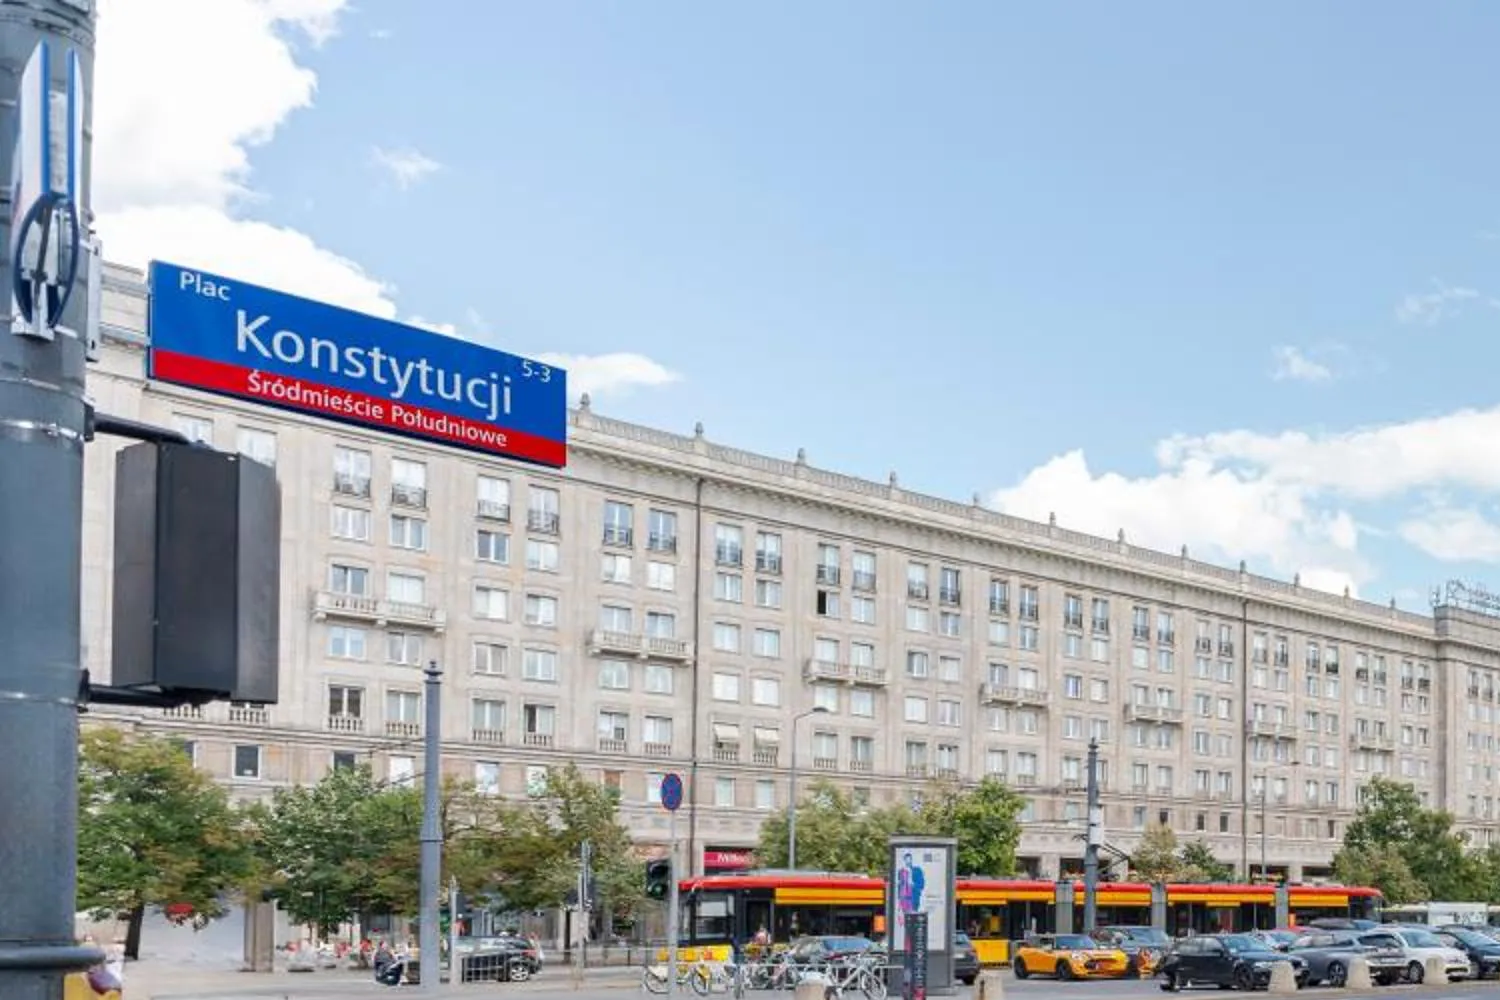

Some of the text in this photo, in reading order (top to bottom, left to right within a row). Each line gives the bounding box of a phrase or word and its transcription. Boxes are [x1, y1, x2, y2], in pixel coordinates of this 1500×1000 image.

[180, 271, 231, 301] Plac
[237, 309, 511, 421] Konstytucji
[522, 359, 551, 383] 5-3
[247, 369, 507, 447] Śródmieście Południowe
